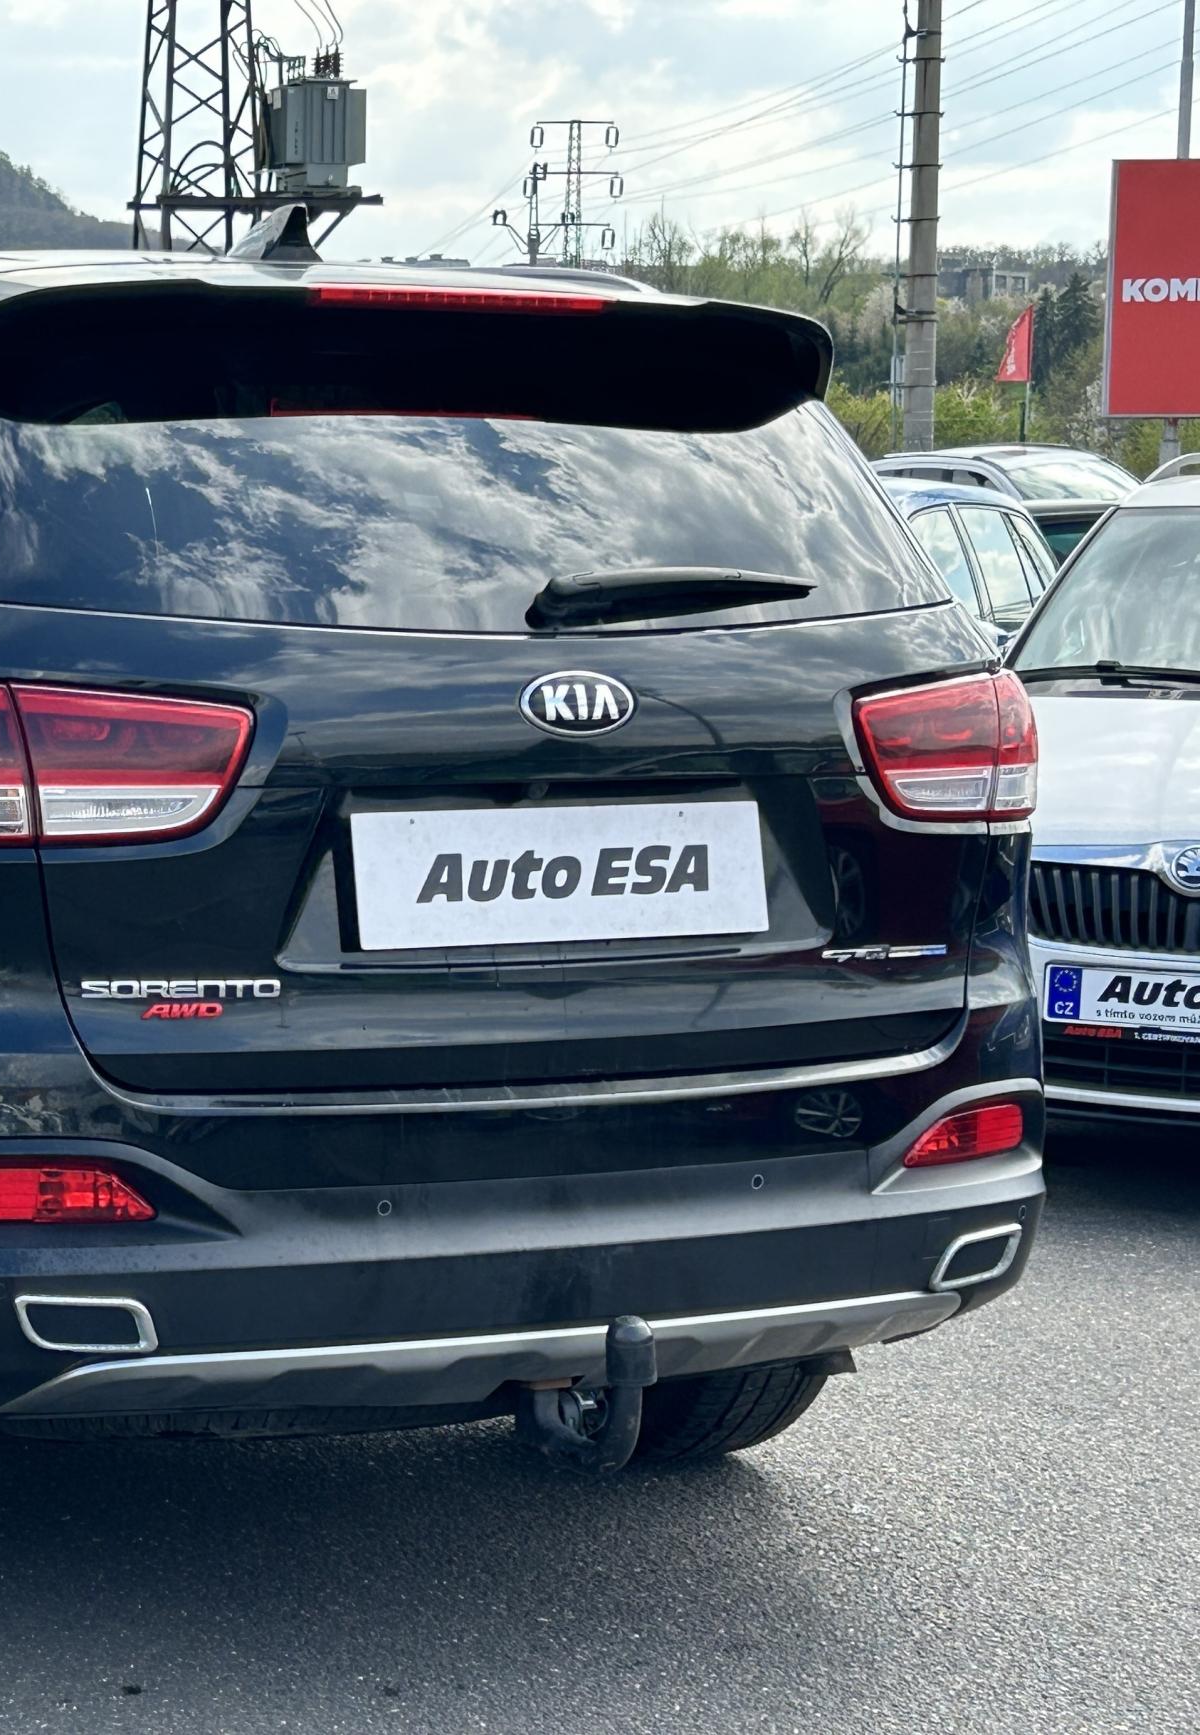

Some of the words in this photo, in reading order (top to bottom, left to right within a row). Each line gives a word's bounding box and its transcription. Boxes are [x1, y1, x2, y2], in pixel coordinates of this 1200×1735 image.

[1122, 278, 1200, 303] KOM
[540, 684, 620, 721] KIA
[416, 849, 582, 904] Auto
[591, 844, 709, 897] ESA
[80, 979, 281, 999] SORENTO
[1097, 975, 1200, 1010] Auto
[140, 1002, 223, 1020] AWD
[1054, 1001, 1074, 1015] CZ
[1064, 1026, 1096, 1037] Auto
